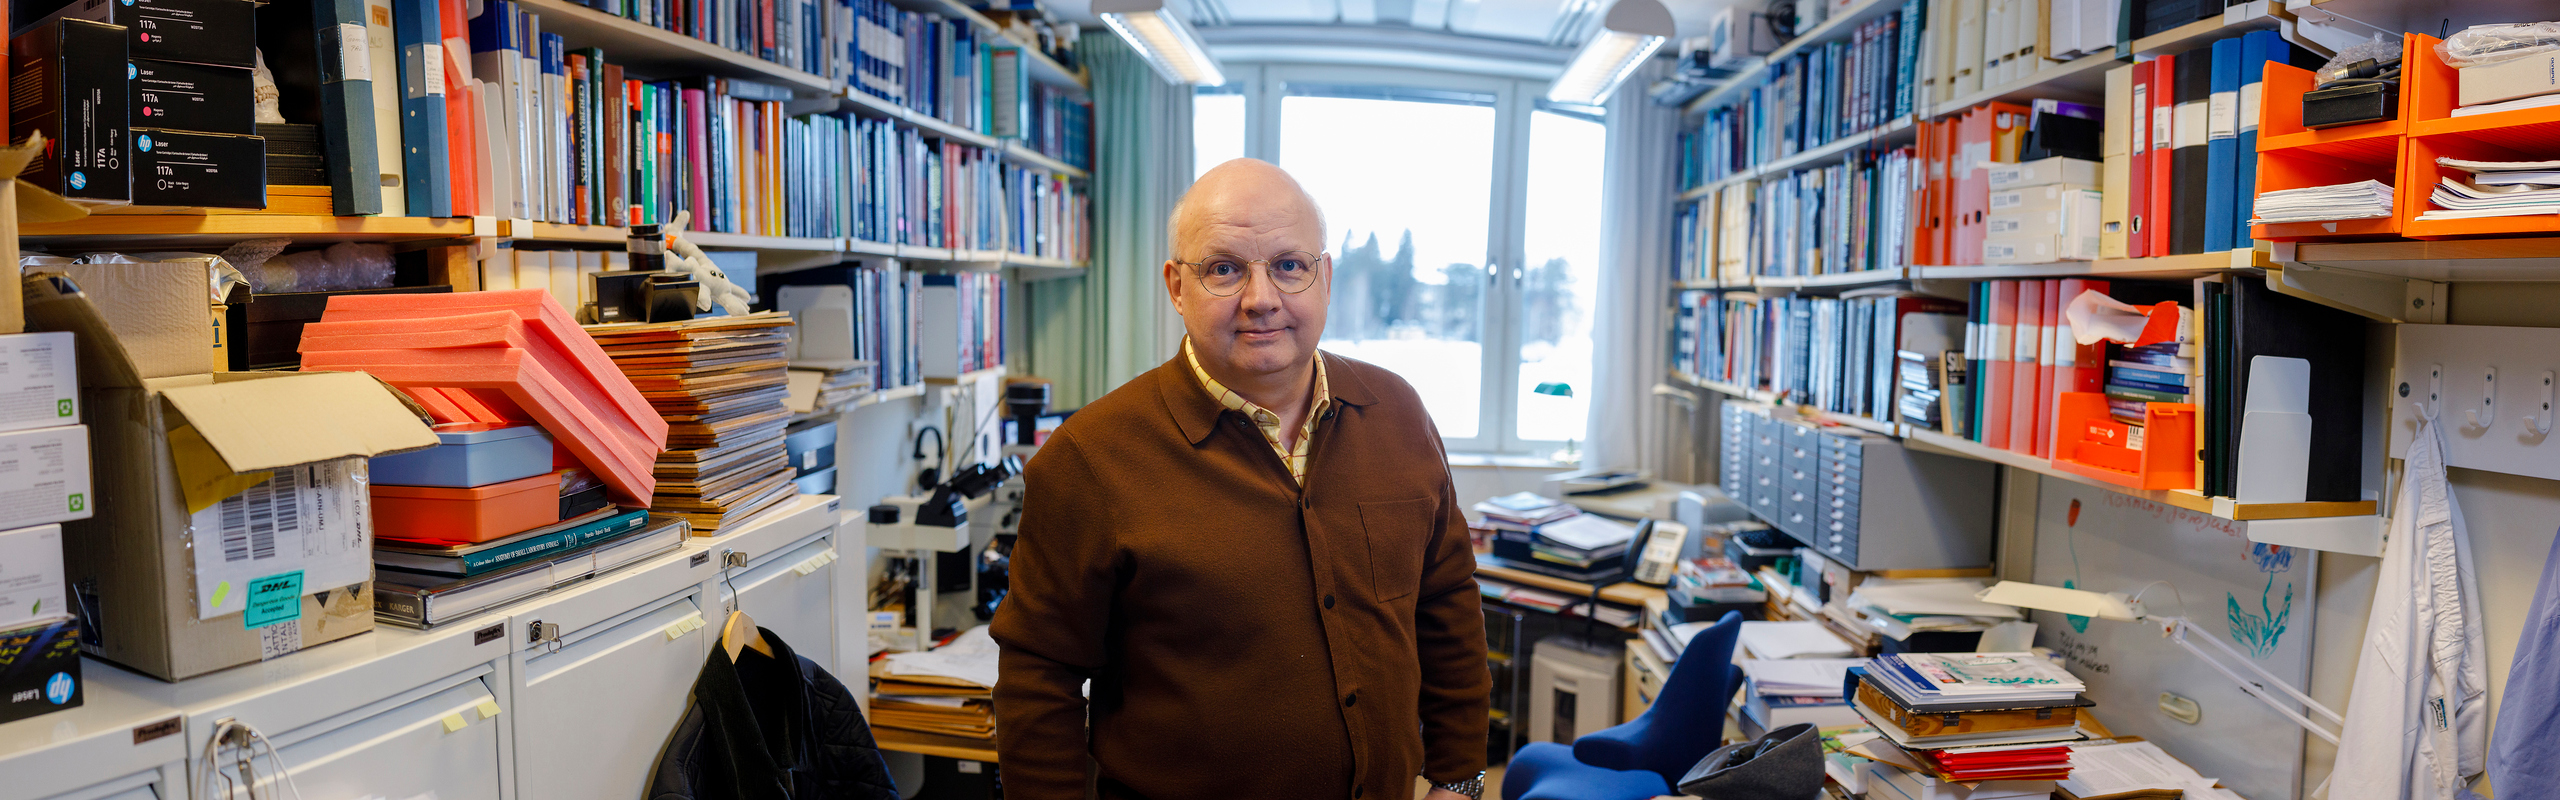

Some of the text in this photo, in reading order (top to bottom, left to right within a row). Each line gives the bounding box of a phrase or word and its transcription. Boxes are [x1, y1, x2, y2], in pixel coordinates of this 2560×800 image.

[139, 19, 157, 30] 117A
[141, 93, 159, 103] 117A
[577, 84, 586, 137] CEREBRAL
[139, 134, 152, 152] hp
[97, 148, 106, 169] 117A
[579, 139, 588, 184] CORTEX
[156, 166, 173, 176] 117A
[70, 173, 86, 188] hp
[315, 479, 324, 531] SE-ARN-UMJ
[261, 580, 290, 593] DHL
[253, 598, 278, 608] Dangerous
[261, 604, 284, 614] Accepted
[389, 602, 414, 614] KARGER
[12, 672, 72, 704] Laser hp
